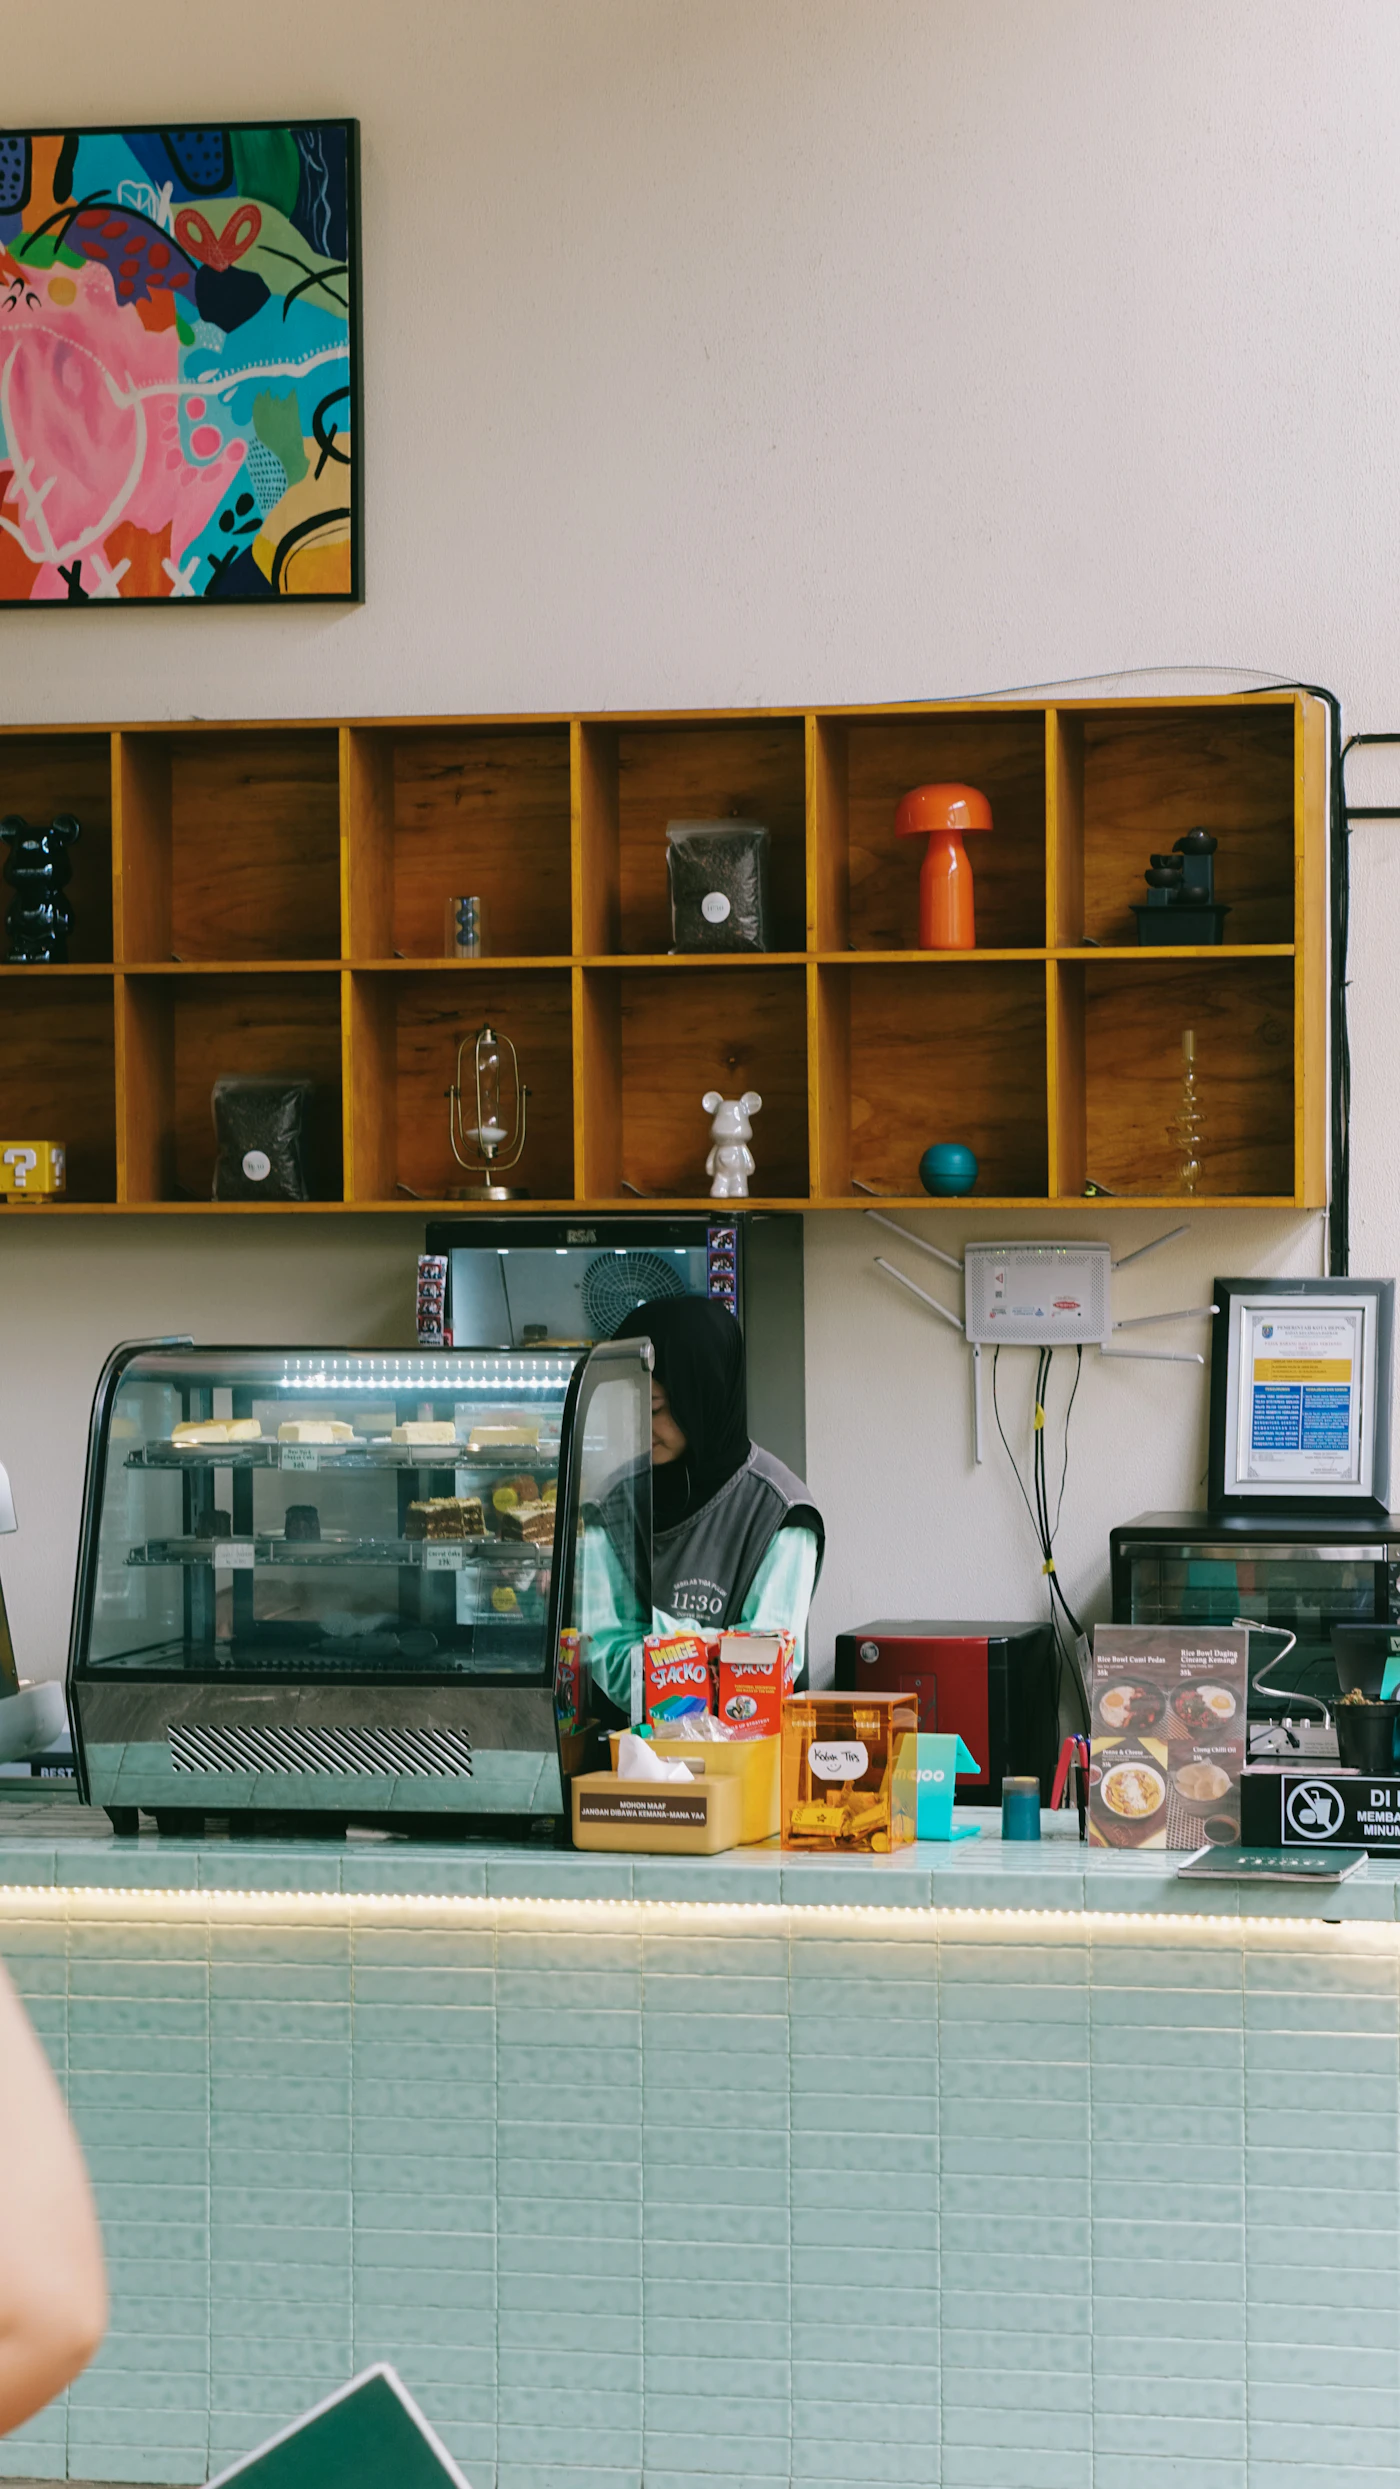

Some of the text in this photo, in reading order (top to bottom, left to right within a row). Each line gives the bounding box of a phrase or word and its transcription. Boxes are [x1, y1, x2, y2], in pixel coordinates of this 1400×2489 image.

[566, 1229, 597, 1244] RSA
[670, 1591, 723, 1614] 11:30
[649, 1639, 699, 1668] IMAGE
[1148, 1656, 1166, 1664] Pedas
[1181, 1649, 1195, 1657] Rice
[1214, 1650, 1238, 1658] Daging
[1180, 1656, 1237, 1665] Cincang Kemangi
[650, 1662, 707, 1690] STACKO
[1370, 1788, 1391, 1808] DI
[619, 1801, 667, 1810] MOHON MAAF
[581, 1808, 706, 1820] JANGAN DIBAWA KEMANA-MANA YAA
